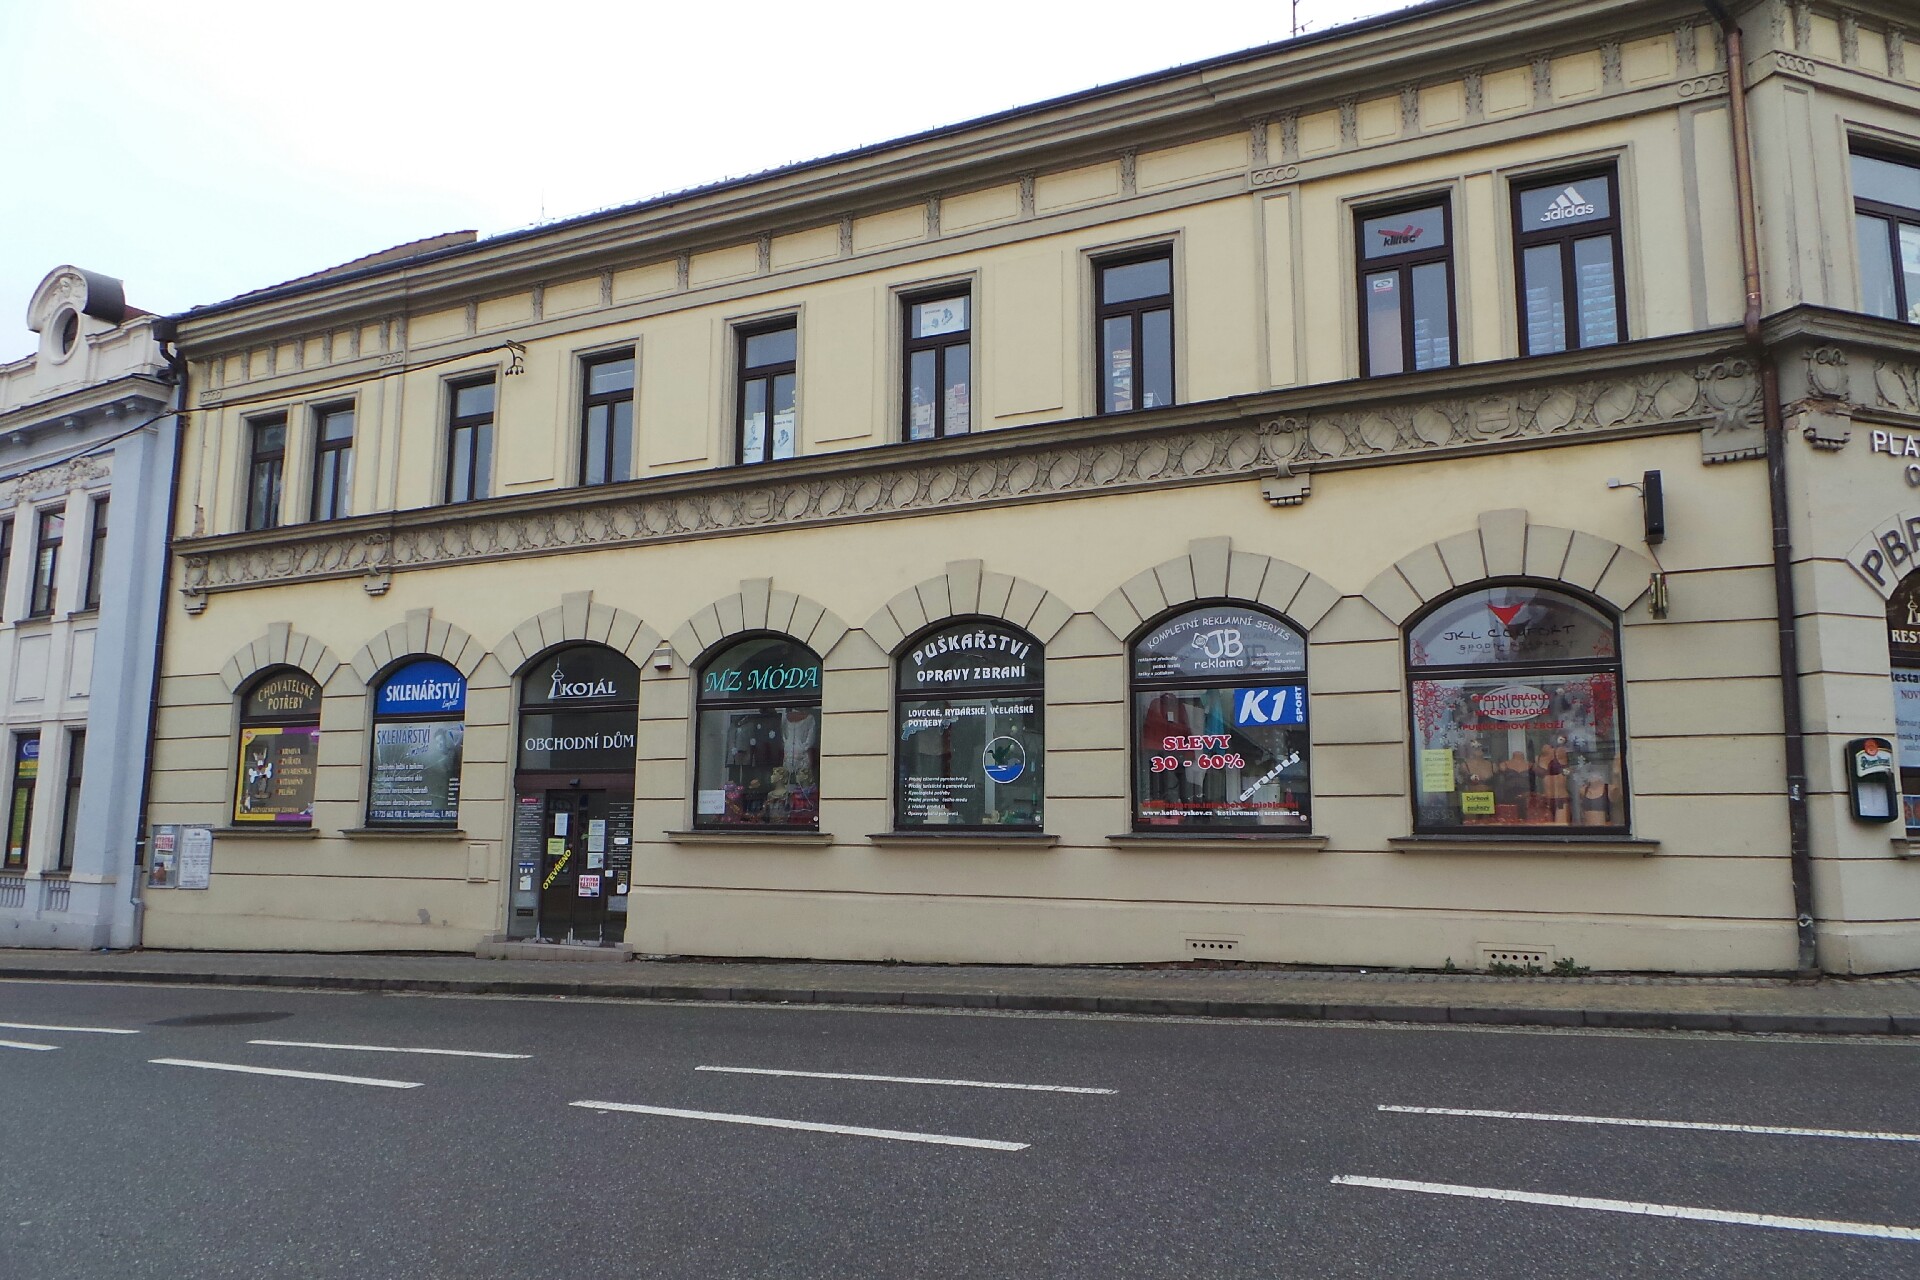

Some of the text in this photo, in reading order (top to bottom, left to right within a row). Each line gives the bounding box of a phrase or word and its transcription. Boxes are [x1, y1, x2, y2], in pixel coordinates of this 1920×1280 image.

[1540, 202, 1594, 222] adidas
[1147, 616, 1291, 649] KOMPLETNÍ REKLAMNÍ SERVIS
[1443, 631, 1481, 641] JKL
[1892, 630, 1920, 643] RES
[912, 630, 1032, 666] PUŠKAŘSTVÍ
[1204, 629, 1244, 659] JB
[917, 663, 1026, 682] OPRAVY ZBRANÍ
[1194, 659, 1244, 669] reklama
[561, 678, 617, 697] KOJÁL
[705, 664, 819, 692] MZ MÓDA
[258, 679, 315, 702] CHOVATELSKÉ
[386, 678, 461, 702] SKLENÁŘSTVÍ
[1472, 693, 1550, 702] SPODNÍ PRÁDLO
[267, 694, 304, 710] POTŘEBY
[908, 704, 1034, 718] LOVECKÉ, RYBÁŘSKÉ, VČELAŘSKÉ
[1239, 686, 1304, 724] K1 SPORT
[1475, 708, 1549, 716] NOČNÍ PRÁDLO
[908, 718, 942, 727] POTŘEBY
[1533, 720, 1564, 729] ZBOŽÍ
[376, 725, 431, 745] SKLENÁŘSTVÍ
[525, 731, 634, 750] OBCHODNÍ DŮM
[1163, 735, 1231, 750] SLEVY
[1151, 756, 1178, 772] 30
[1197, 753, 1245, 770] 60%
[543, 849, 572, 890] OTEVŘENO
